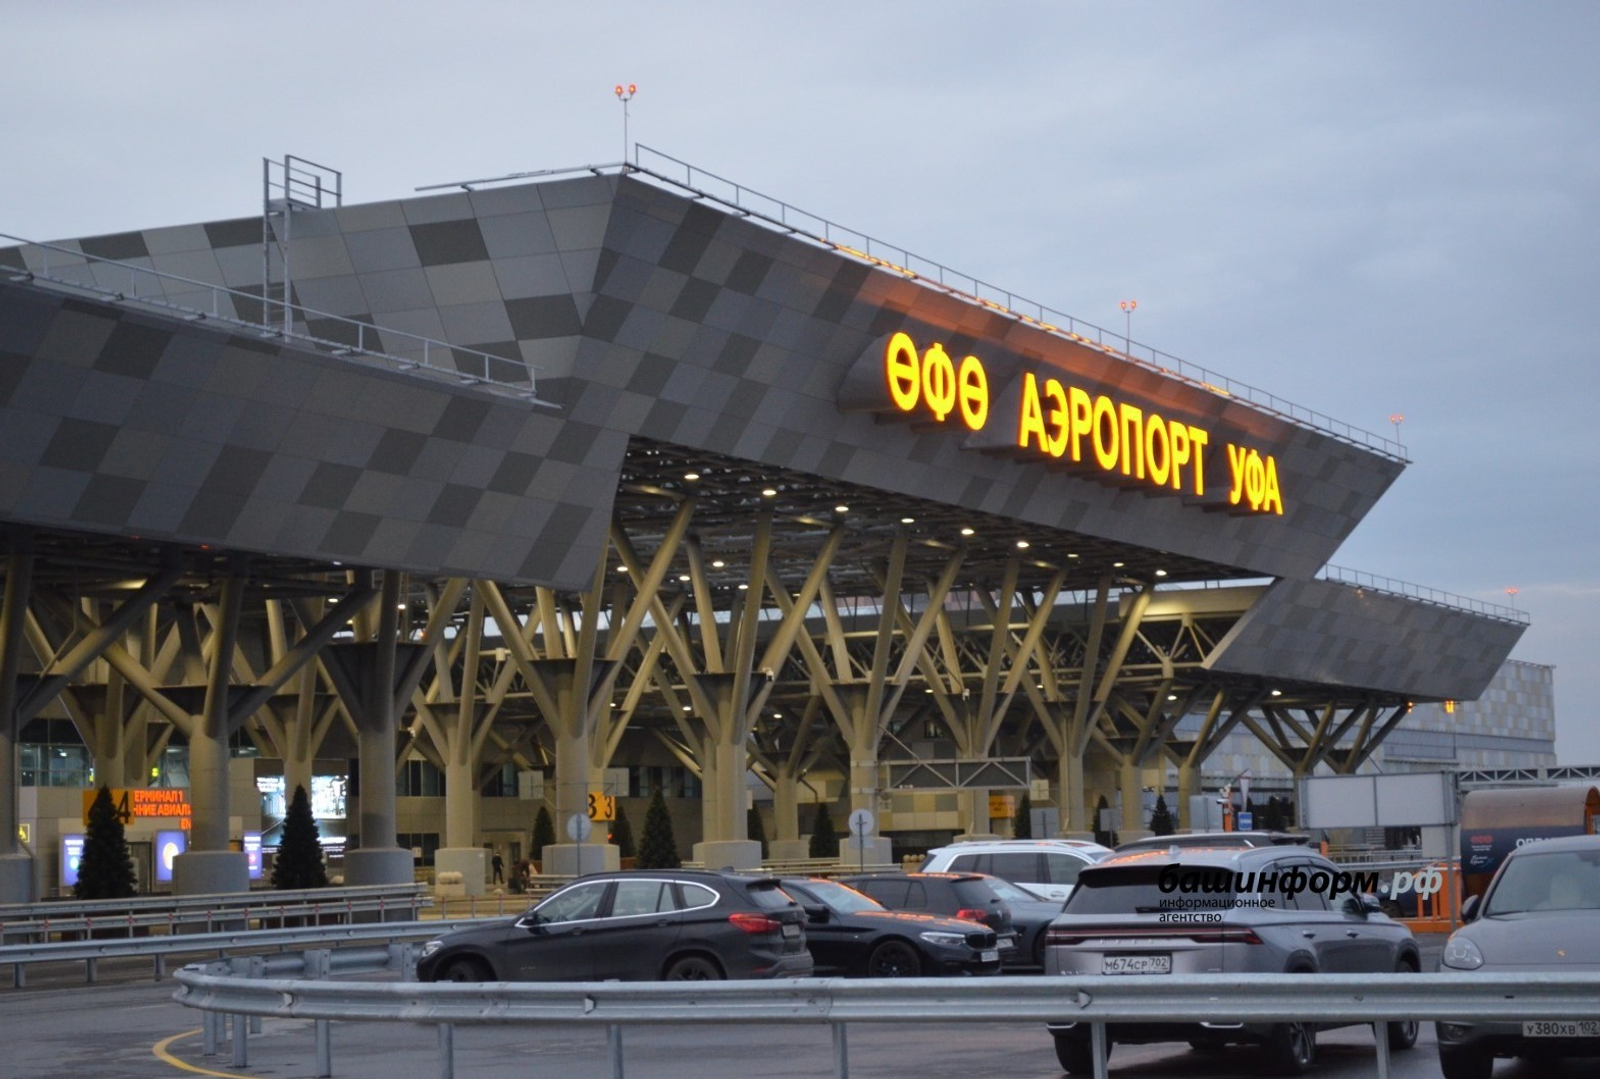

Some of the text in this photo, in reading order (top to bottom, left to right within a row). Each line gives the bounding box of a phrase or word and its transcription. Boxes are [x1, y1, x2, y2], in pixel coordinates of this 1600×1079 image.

[1018, 372, 1209, 497] АЭРОПОРТ
[1226, 443, 1284, 516] УФА
[134, 790, 178, 803] ЕРМИНАЛ
[117, 791, 131, 824] 4
[604, 795, 613, 819] 3
[1105, 957, 1167, 971] М674СР 702
[1527, 1021, 1597, 1035] У380ХВ 102
